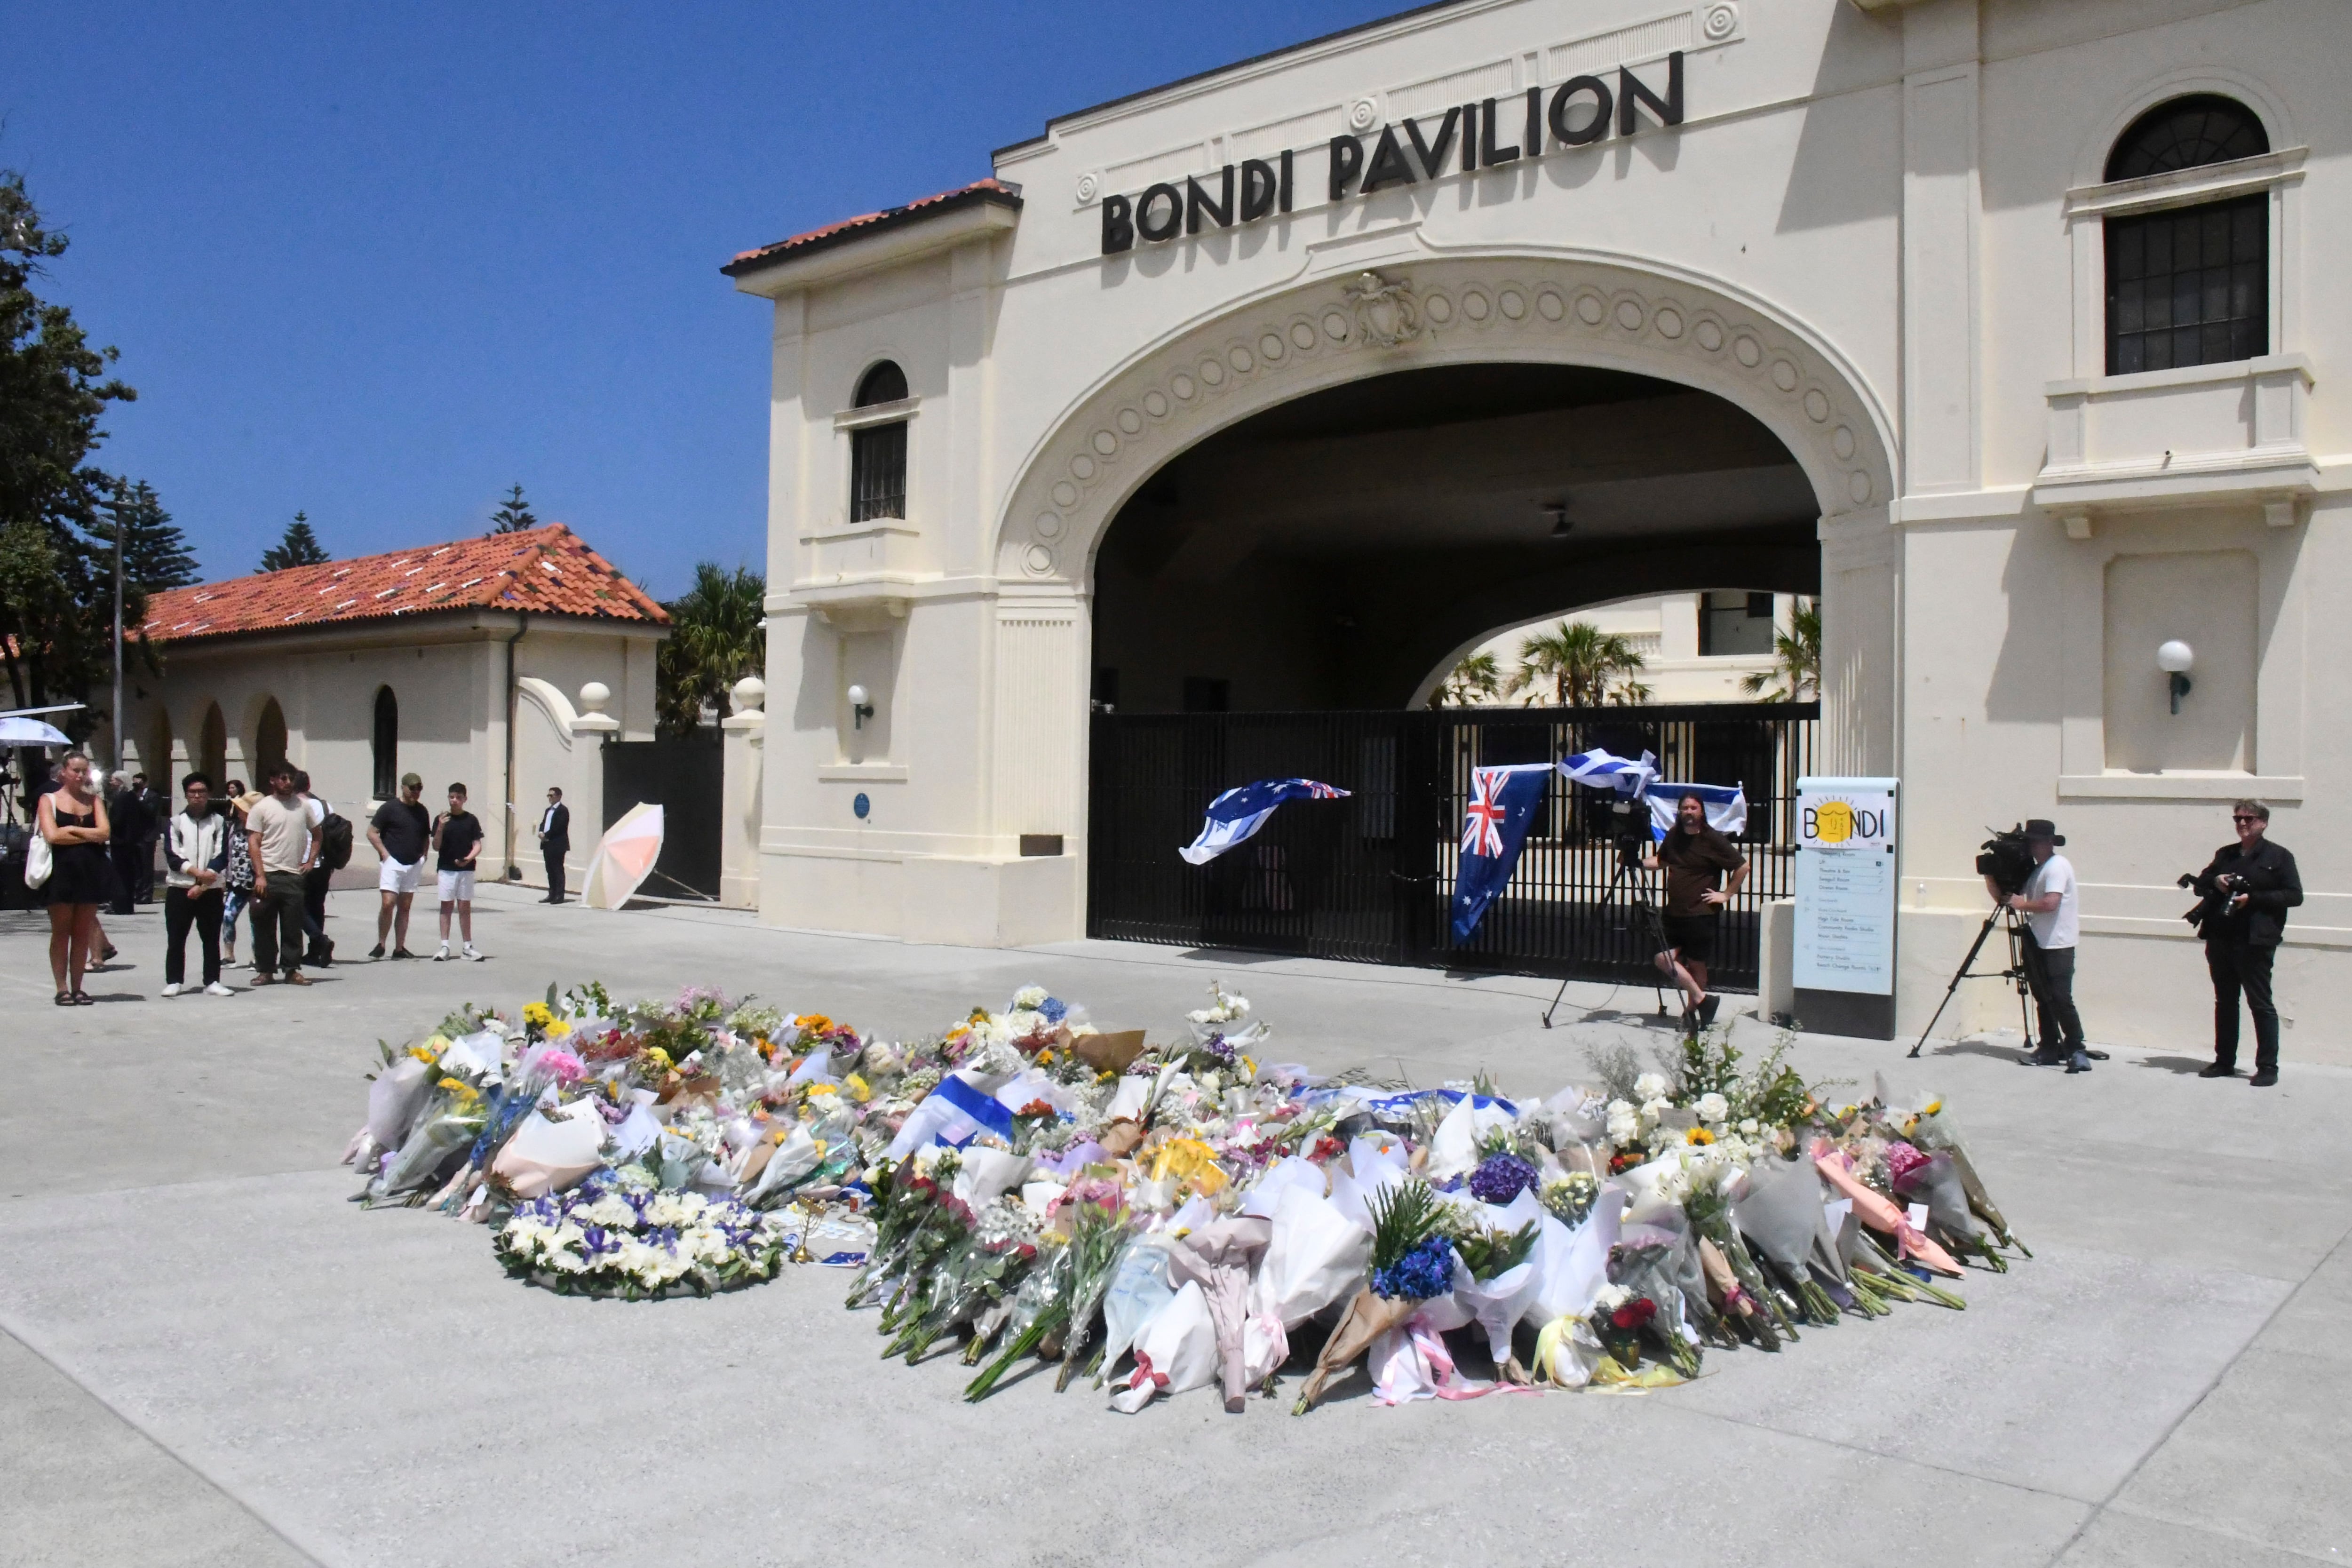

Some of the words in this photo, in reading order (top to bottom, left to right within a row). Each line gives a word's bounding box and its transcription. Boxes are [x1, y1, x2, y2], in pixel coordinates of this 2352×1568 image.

[1102, 149, 1293, 255] BONDI
[1330, 51, 1684, 200] PAVILION
[1804, 802, 1883, 843] BONDI
